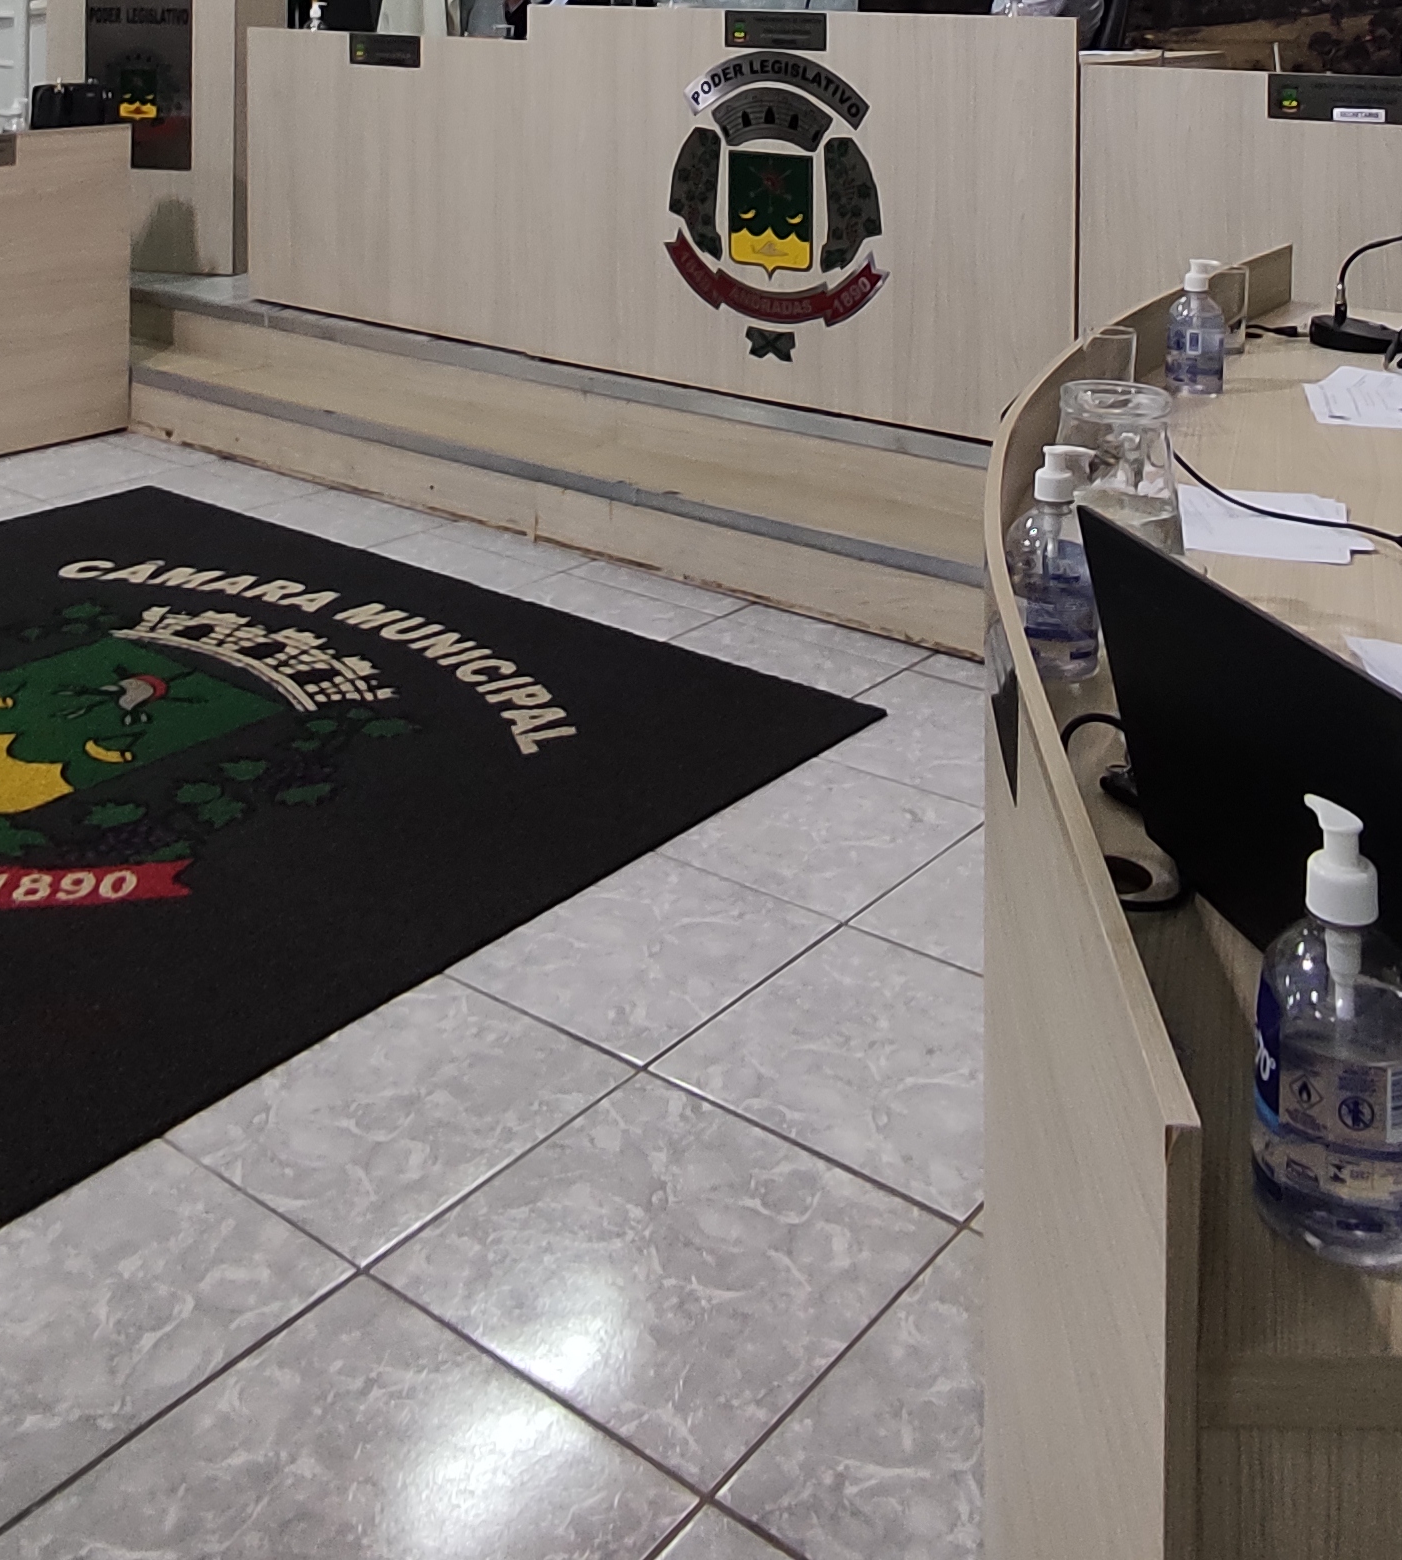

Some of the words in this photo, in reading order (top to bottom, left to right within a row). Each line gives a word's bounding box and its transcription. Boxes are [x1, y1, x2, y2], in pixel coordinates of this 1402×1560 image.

[691, 63, 745, 106] PODER
[749, 59, 861, 118] LEGISLATIVO
[833, 276, 872, 313] 1890
[58, 559, 341, 613] CÂMARA
[333, 602, 578, 755] MUNICIPAL
